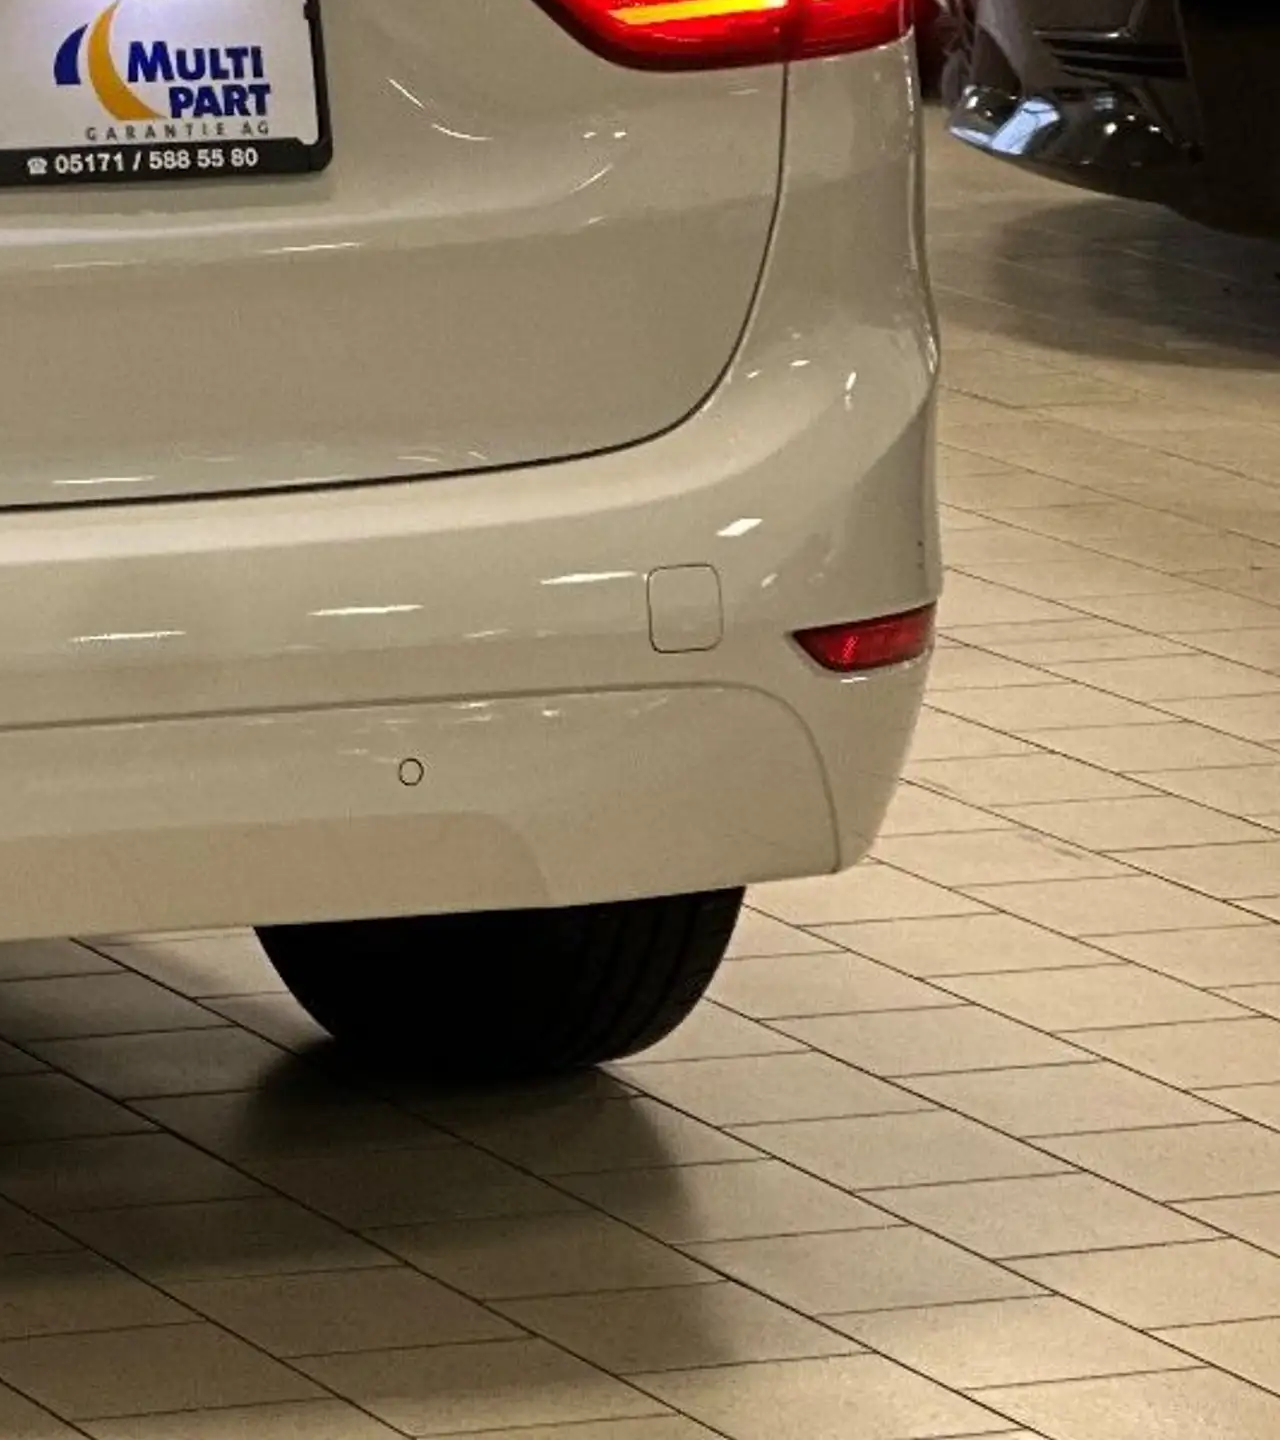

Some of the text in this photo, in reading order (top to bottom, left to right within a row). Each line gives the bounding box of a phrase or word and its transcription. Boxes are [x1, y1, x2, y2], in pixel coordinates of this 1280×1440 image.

[169, 84, 271, 119] PART
[85, 120, 270, 141] GARANTIE AG
[54, 153, 125, 175] 05171
[148, 151, 191, 170] 588
[197, 148, 225, 168] 55
[230, 147, 259, 167] 80
